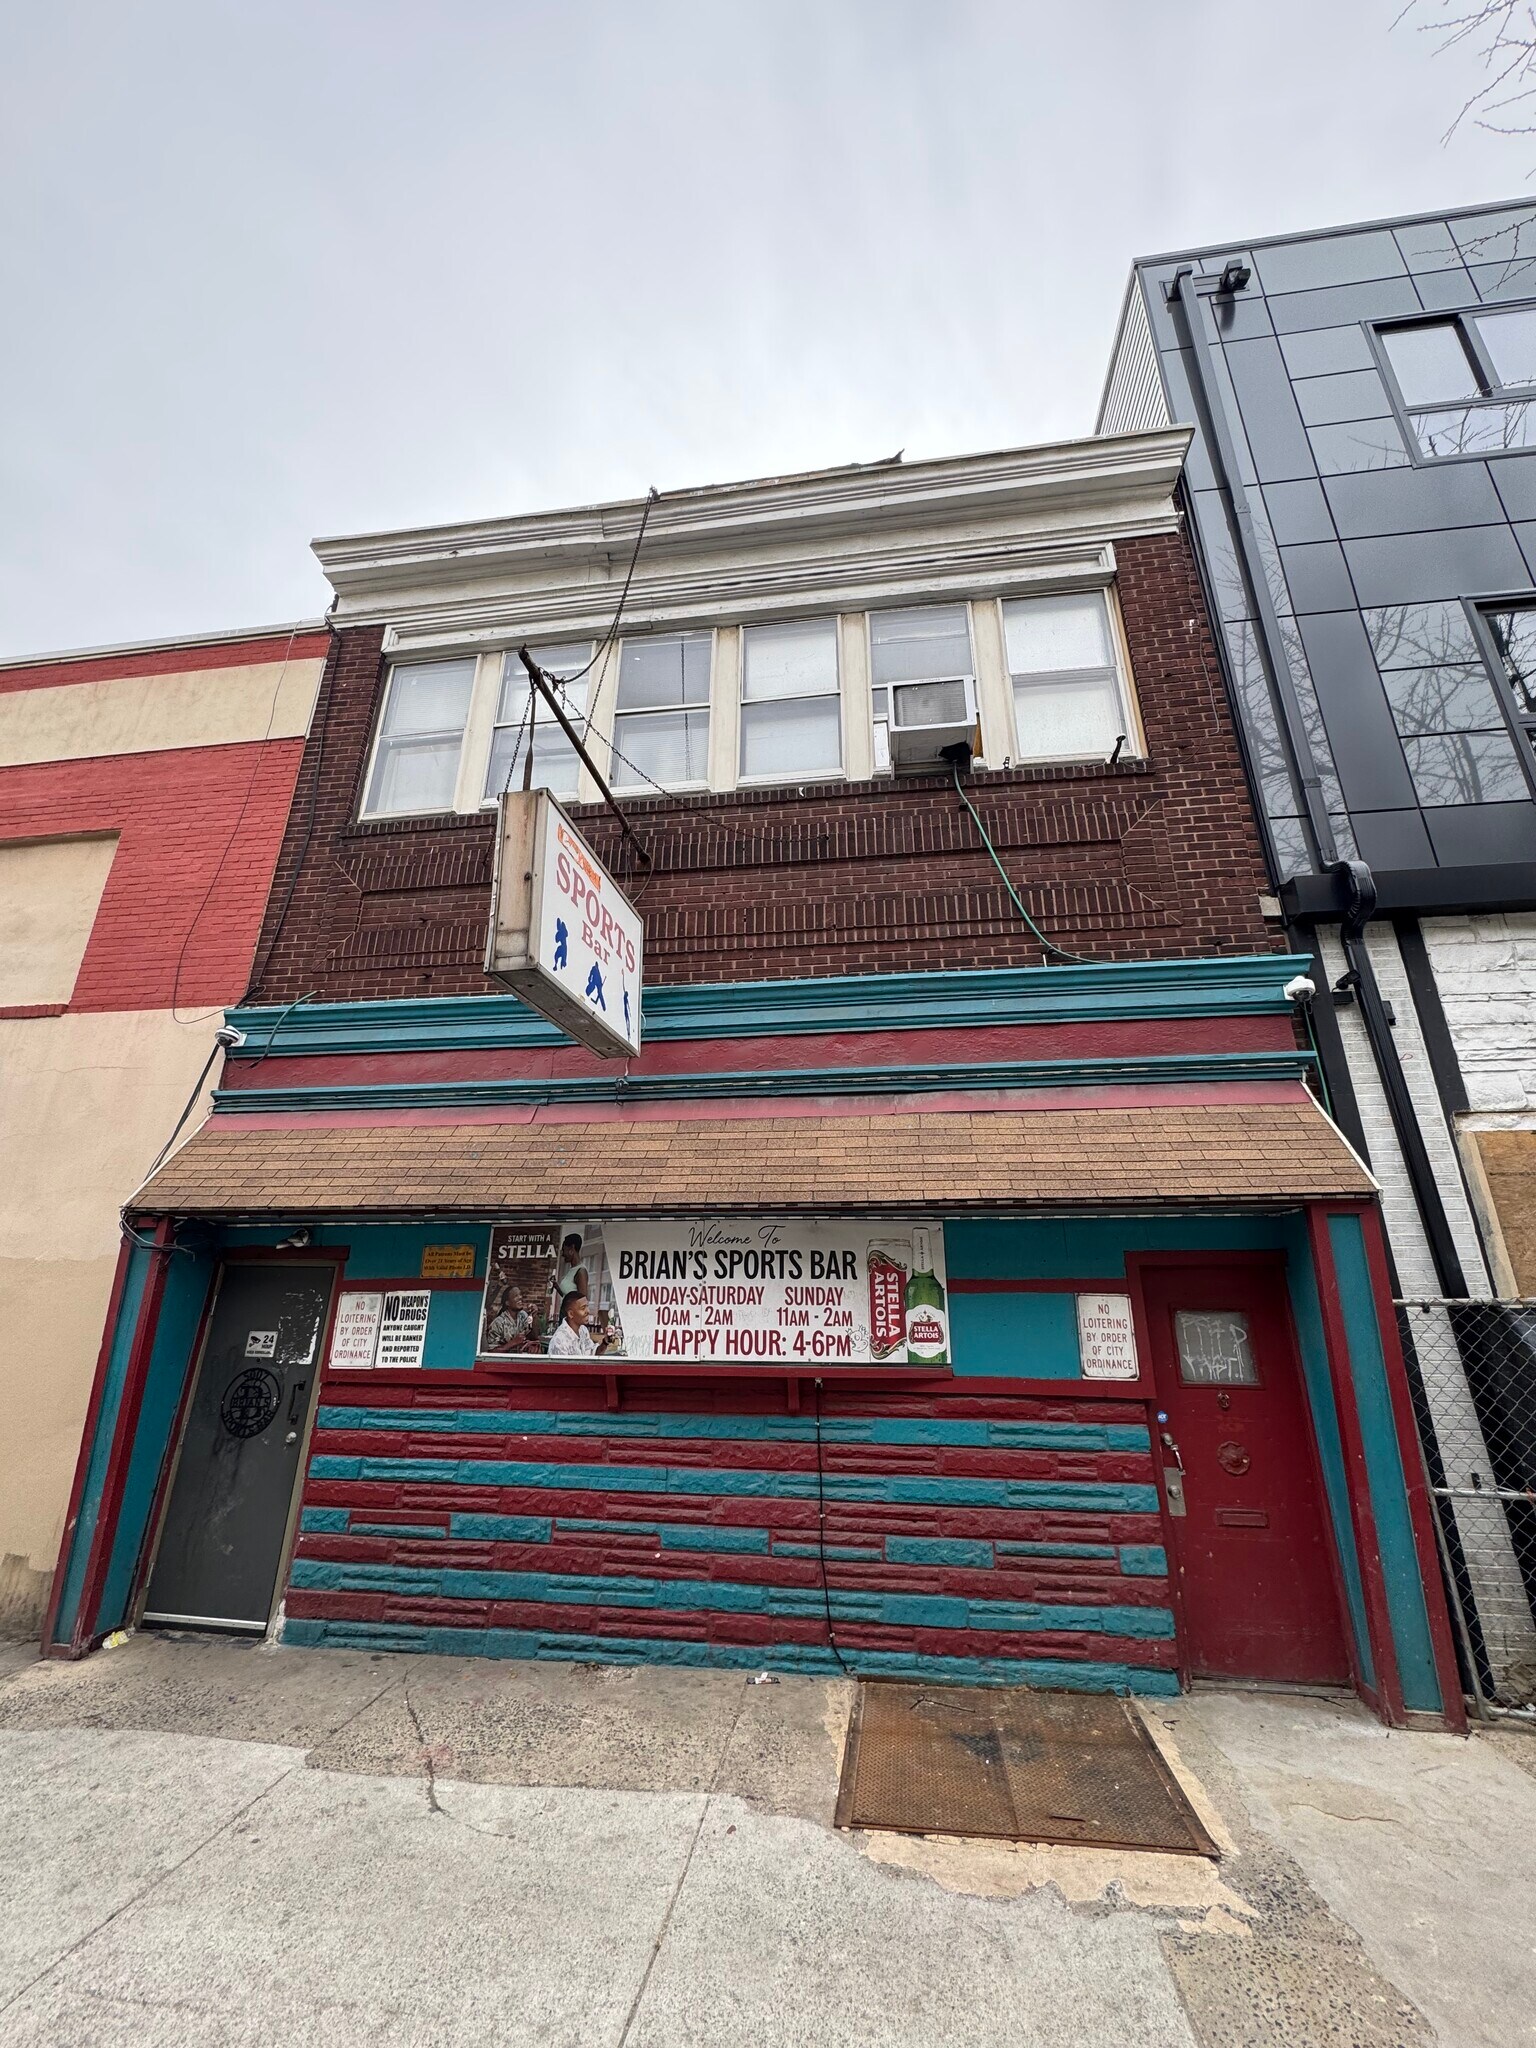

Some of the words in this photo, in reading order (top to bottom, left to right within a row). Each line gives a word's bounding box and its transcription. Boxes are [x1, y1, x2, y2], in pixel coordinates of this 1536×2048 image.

[556, 852, 635, 974] SPORTS
[581, 920, 611, 966] Bar
[546, 1234, 550, 1242] A
[688, 1224, 752, 1247] Welcome
[758, 1225, 786, 1247] To
[498, 1244, 557, 1259] STELLA
[619, 1250, 708, 1280] BRIAN'S
[714, 1250, 803, 1280] SPORTS
[810, 1250, 857, 1280] BAR
[401, 1295, 429, 1308] WEAPON'S
[626, 1286, 765, 1305] MONDAY-SATURDAY
[784, 1286, 844, 1306] SUNDAY
[355, 1301, 365, 1310] NO
[384, 1296, 400, 1321] NO
[874, 1272, 887, 1337] ARTOIS
[886, 1272, 901, 1337] STELLA
[1098, 1304, 1110, 1314] NO
[340, 1313, 376, 1323] LOITERING
[399, 1308, 427, 1321] DRUGS
[655, 1306, 690, 1325] 10AM
[704, 1306, 733, 1325] 2AM
[777, 1307, 809, 1326] 11AM
[823, 1307, 853, 1326] 2AM
[1082, 1318, 1128, 1329] LOITERING
[340, 1327, 349, 1335] BY
[352, 1326, 372, 1335] ORDER
[263, 1334, 275, 1344] 24
[342, 1339, 350, 1347] OF
[353, 1338, 367, 1347] CITY
[653, 1329, 719, 1355] HAPPY
[726, 1329, 787, 1356] HOUR:
[792, 1330, 852, 1357] 4-6PM
[1086, 1332, 1096, 1342] BY
[1101, 1332, 1127, 1343] ORDER
[334, 1350, 371, 1359] ORDINANCE
[1092, 1345, 1102, 1355] OF
[1106, 1345, 1124, 1356] CITY
[1086, 1359, 1133, 1370] ORDINANCE
